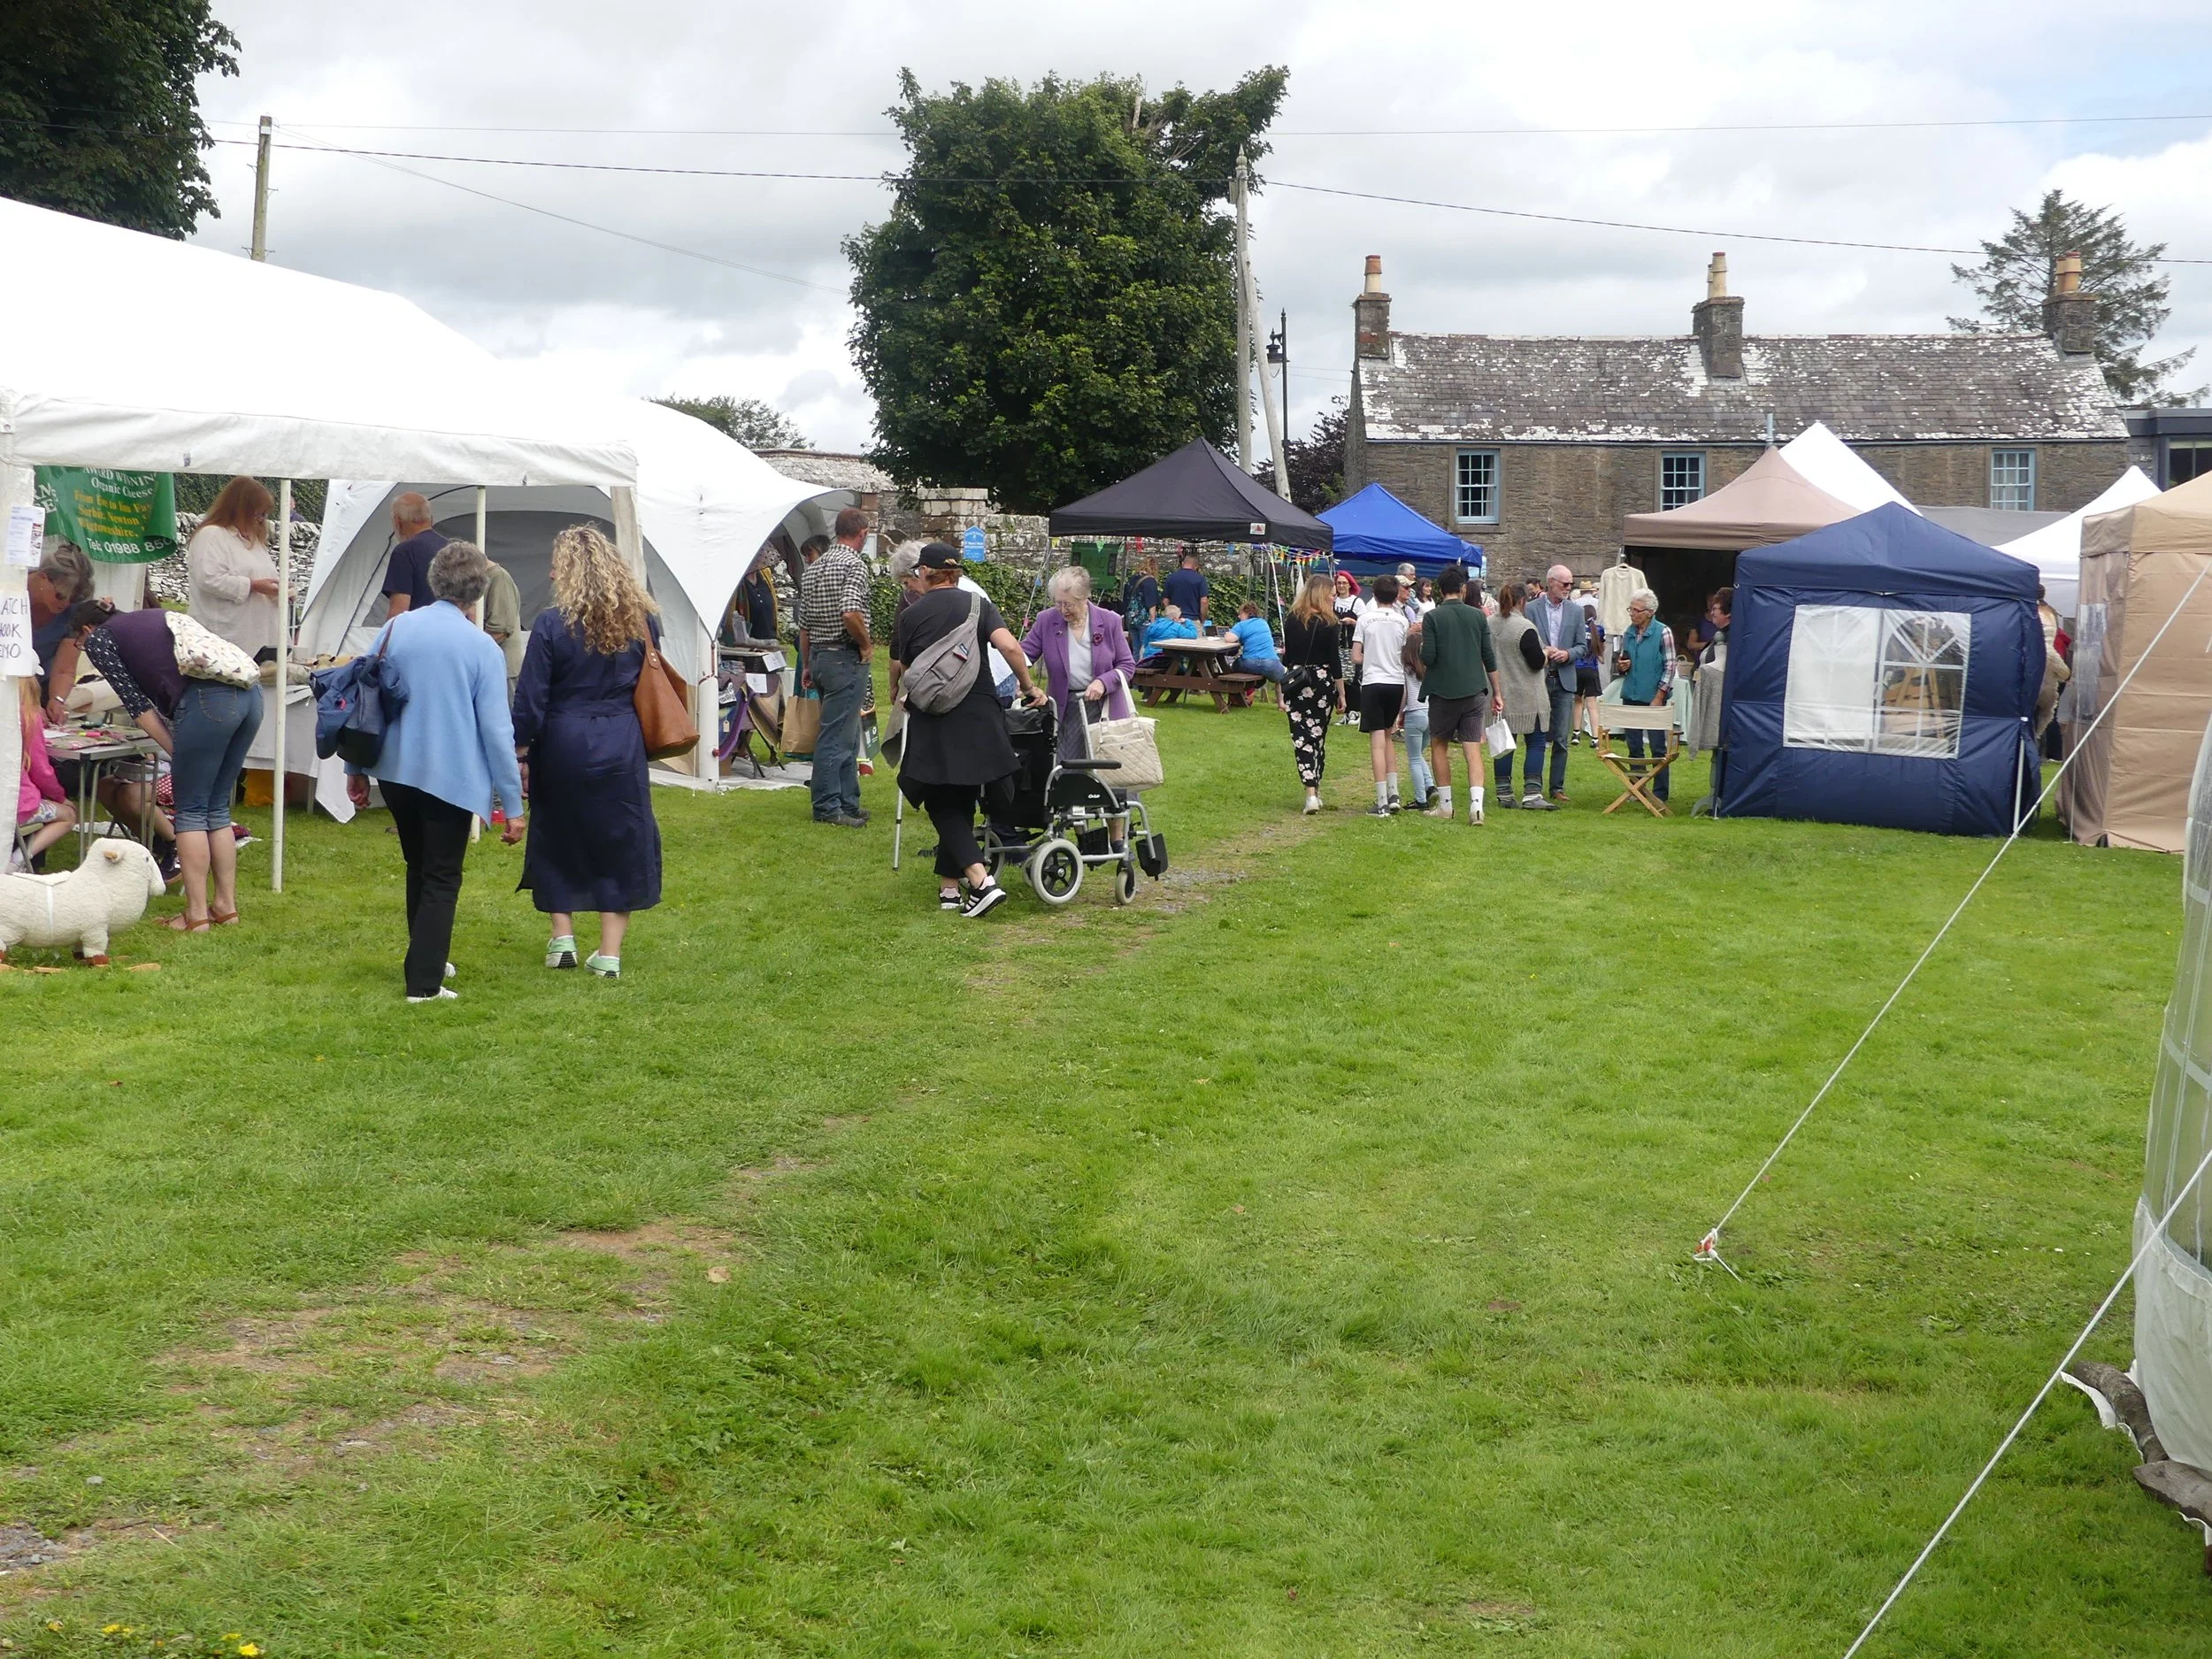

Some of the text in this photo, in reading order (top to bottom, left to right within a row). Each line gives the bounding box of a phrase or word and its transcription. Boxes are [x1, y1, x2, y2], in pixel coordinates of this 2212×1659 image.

[91, 478, 121, 494] Organic
[115, 472, 157, 487] WINNIN
[108, 512, 140, 525] Newton
[104, 542, 141, 554] 01988
